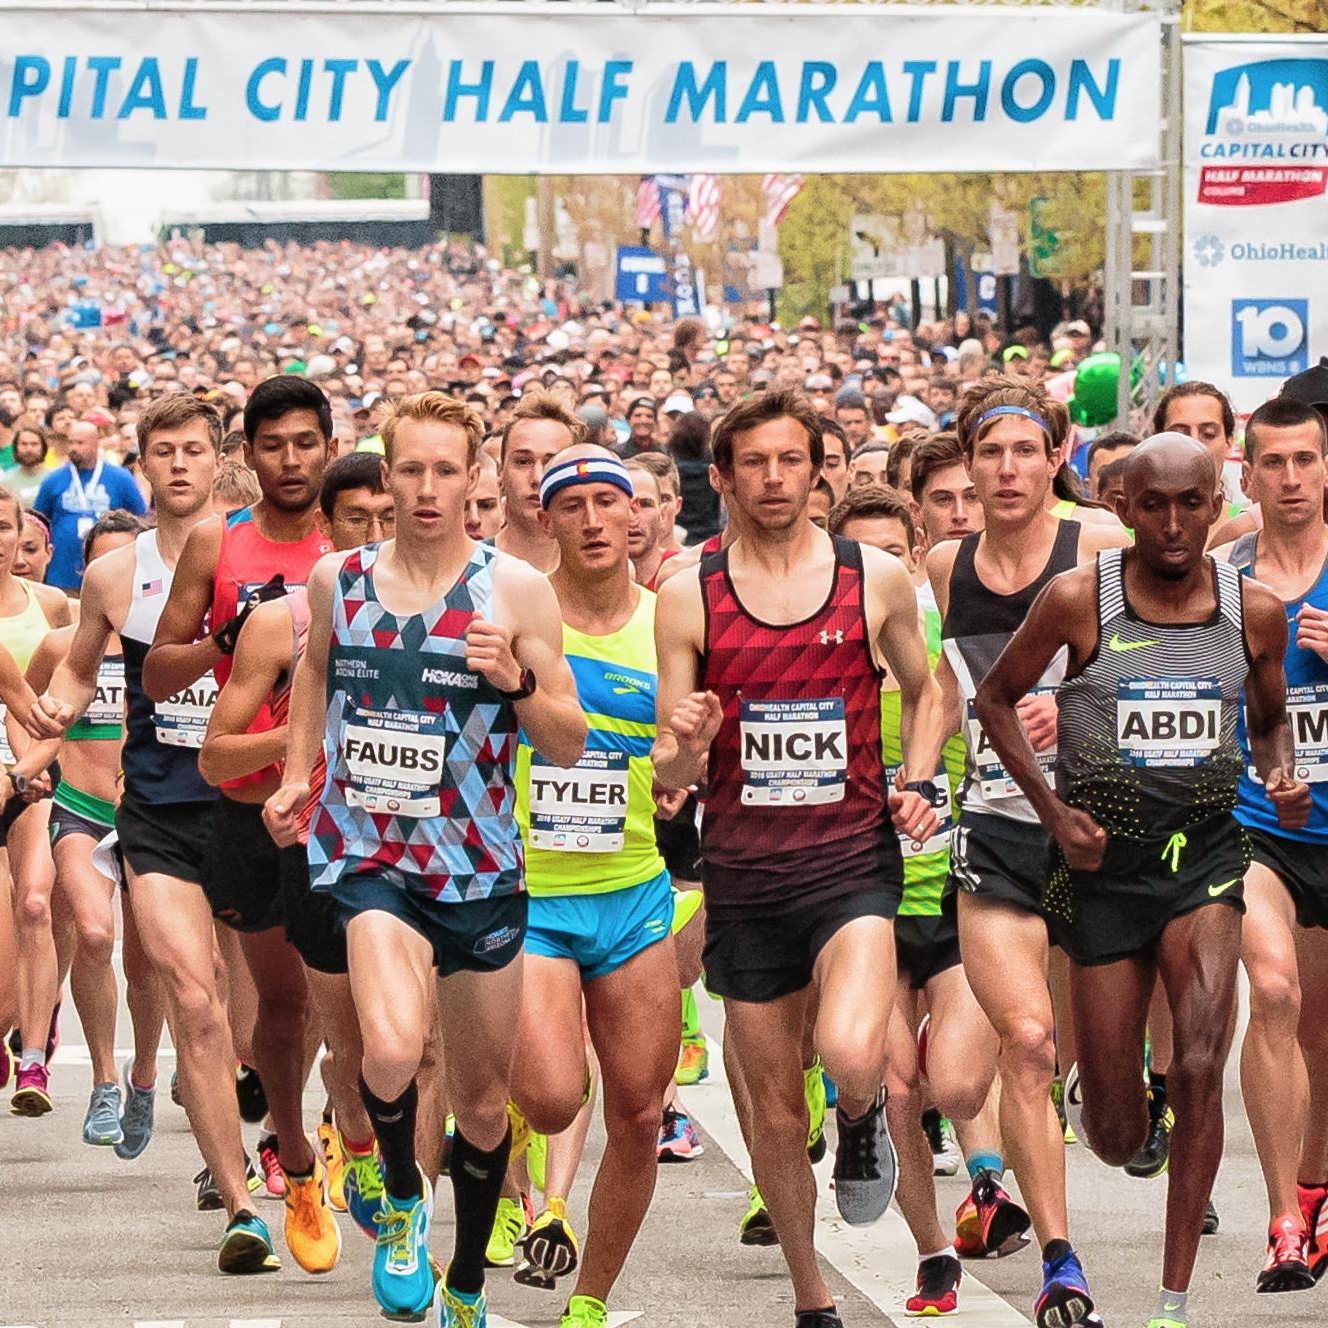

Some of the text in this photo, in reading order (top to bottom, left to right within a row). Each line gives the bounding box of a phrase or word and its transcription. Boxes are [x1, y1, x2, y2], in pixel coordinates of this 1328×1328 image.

[245, 57, 410, 122] CITY
[443, 60, 633, 123] HALF
[665, 58, 1121, 124] MARATHON
[1237, 306, 1304, 358] 10
[357, 668, 379, 679] ELITE
[422, 668, 460, 686] HOKA
[604, 672, 651, 690] BROOKS
[1290, 686, 1314, 694] CAPITAL
[791, 703, 817, 711] CAPITAL
[819, 702, 834, 710] CITY
[393, 712, 419, 723] CAPITAL
[420, 715, 436, 725] CITY
[1121, 710, 1216, 740] ABDI
[346, 739, 439, 772] FAUBS
[609, 751, 623, 760] CITY
[745, 732, 843, 761] NICK
[531, 779, 626, 805] TYLER
